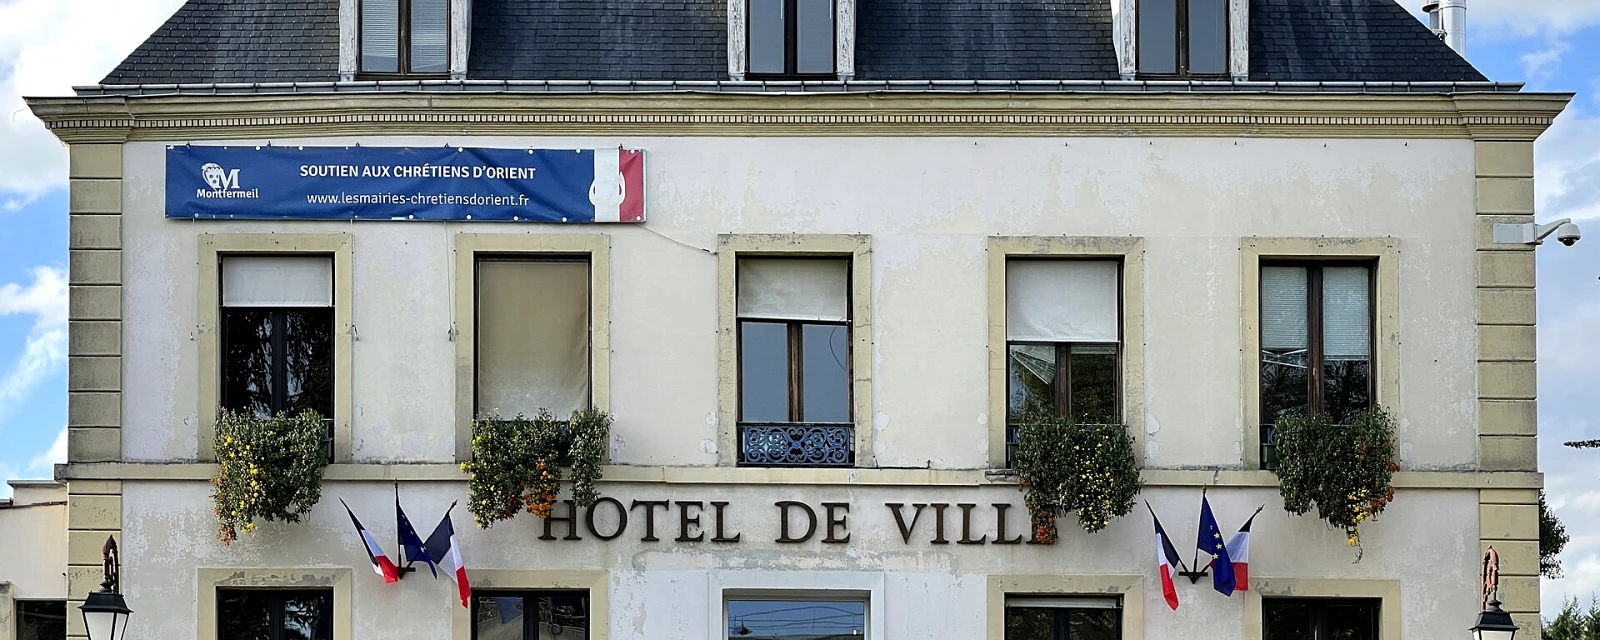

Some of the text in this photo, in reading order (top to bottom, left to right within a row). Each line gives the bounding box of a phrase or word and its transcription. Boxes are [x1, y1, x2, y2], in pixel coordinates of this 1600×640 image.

[300, 165, 358, 177] SOUTIEN
[362, 165, 391, 178] AUX
[393, 163, 470, 178] CHRÉTIENS
[196, 188, 259, 199] Montfermeil
[306, 191, 529, 206] www.lesmairies-chretiensdorient.fr
[538, 497, 1055, 545] HOTEL DE VILL
